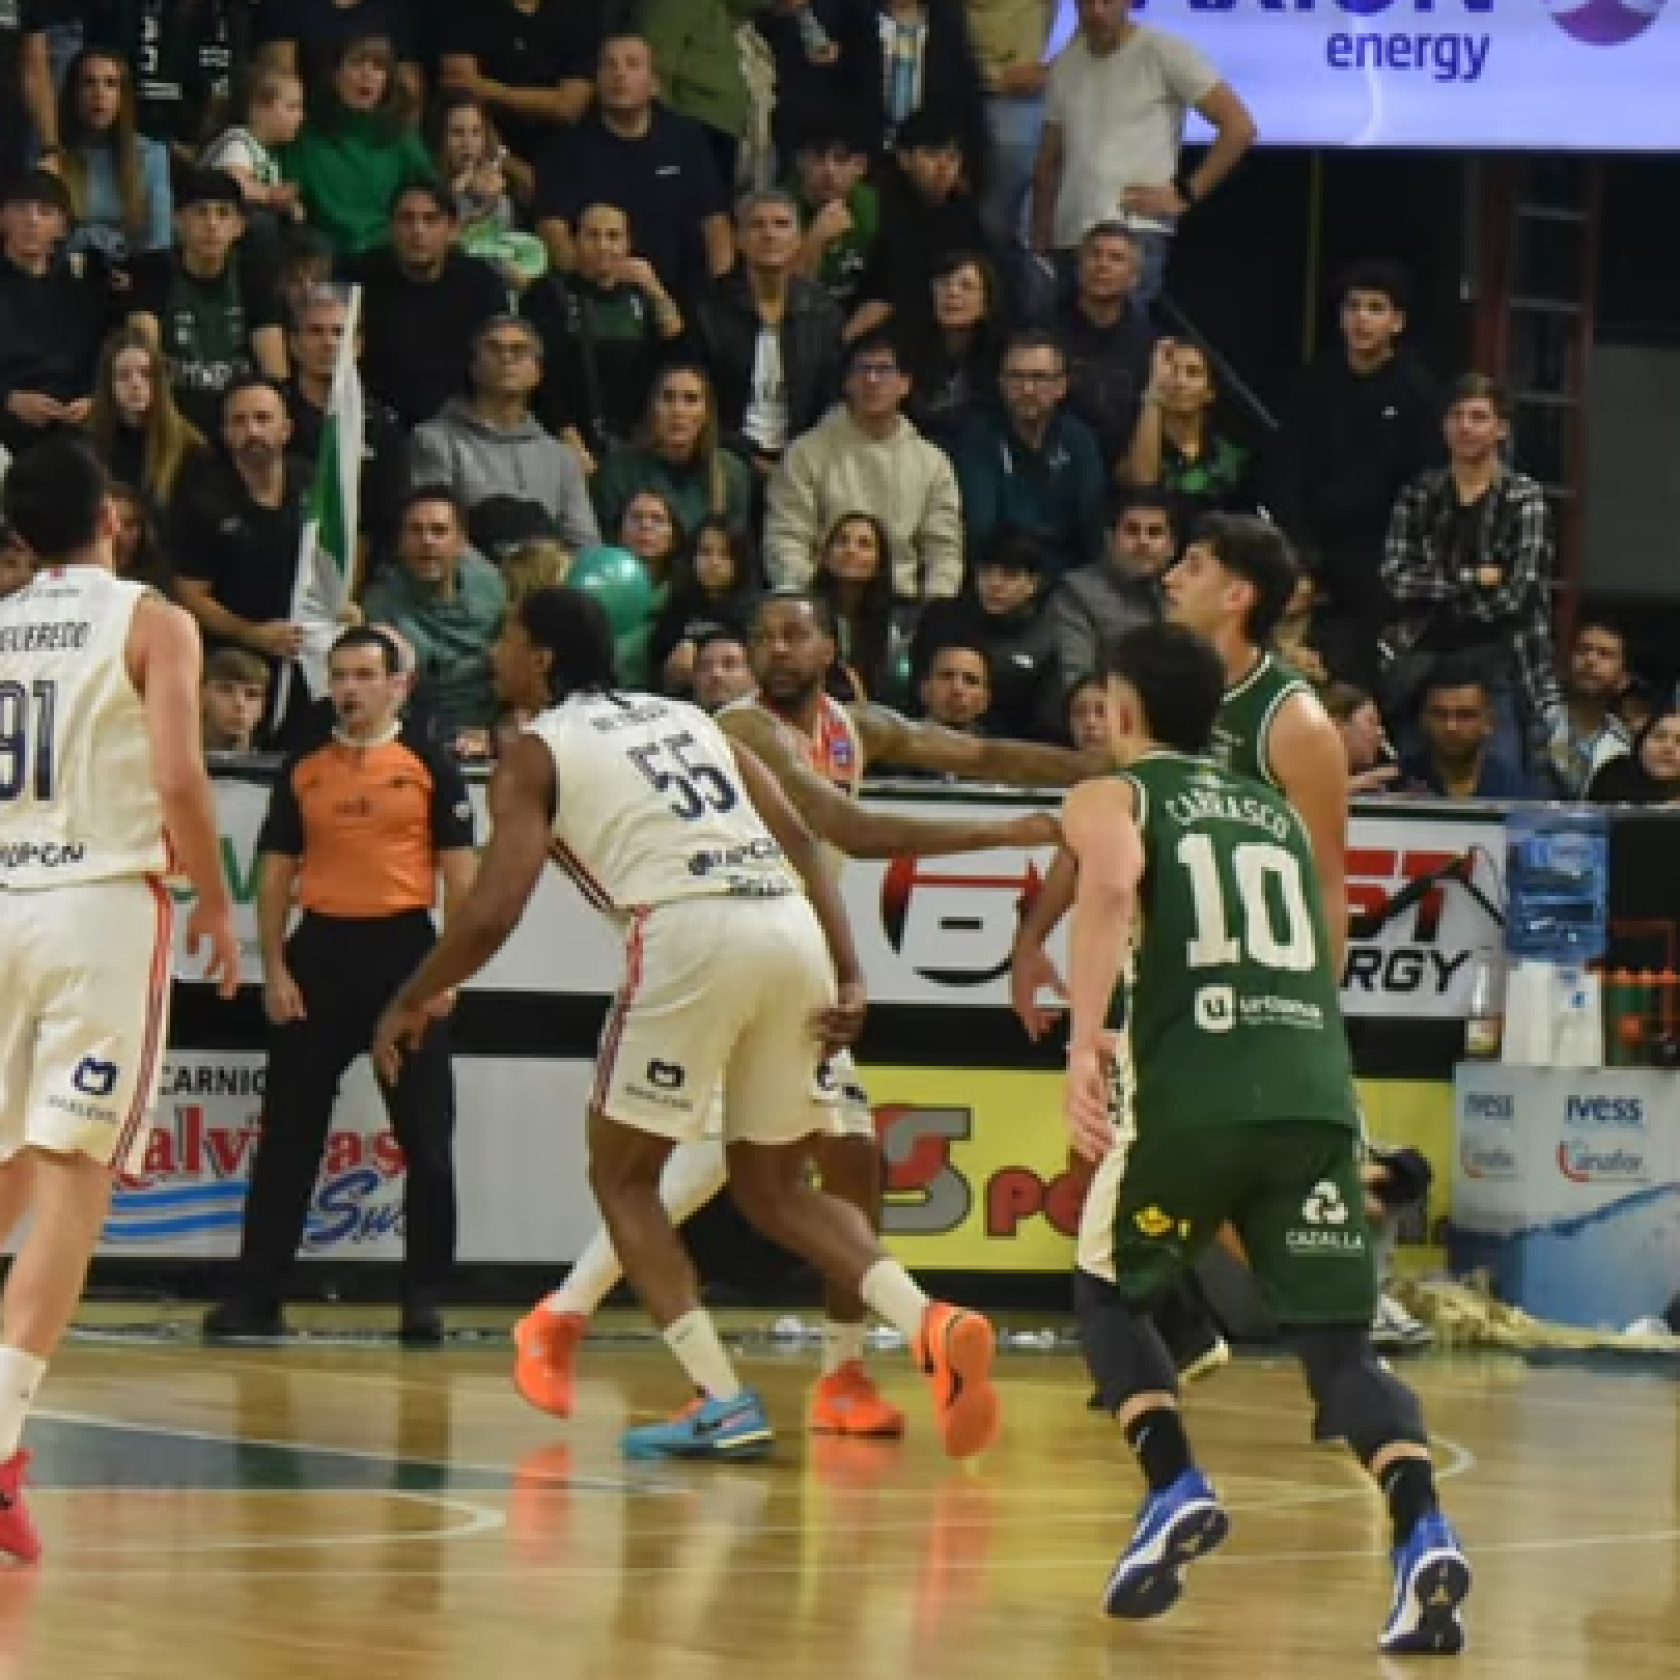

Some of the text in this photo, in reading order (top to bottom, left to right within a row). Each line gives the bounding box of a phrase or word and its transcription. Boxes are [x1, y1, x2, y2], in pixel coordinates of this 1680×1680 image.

[1326, 31, 1491, 83] energy
[0, 679, 56, 801] 91
[626, 731, 739, 821] 55
[1176, 833, 1317, 972] 10
